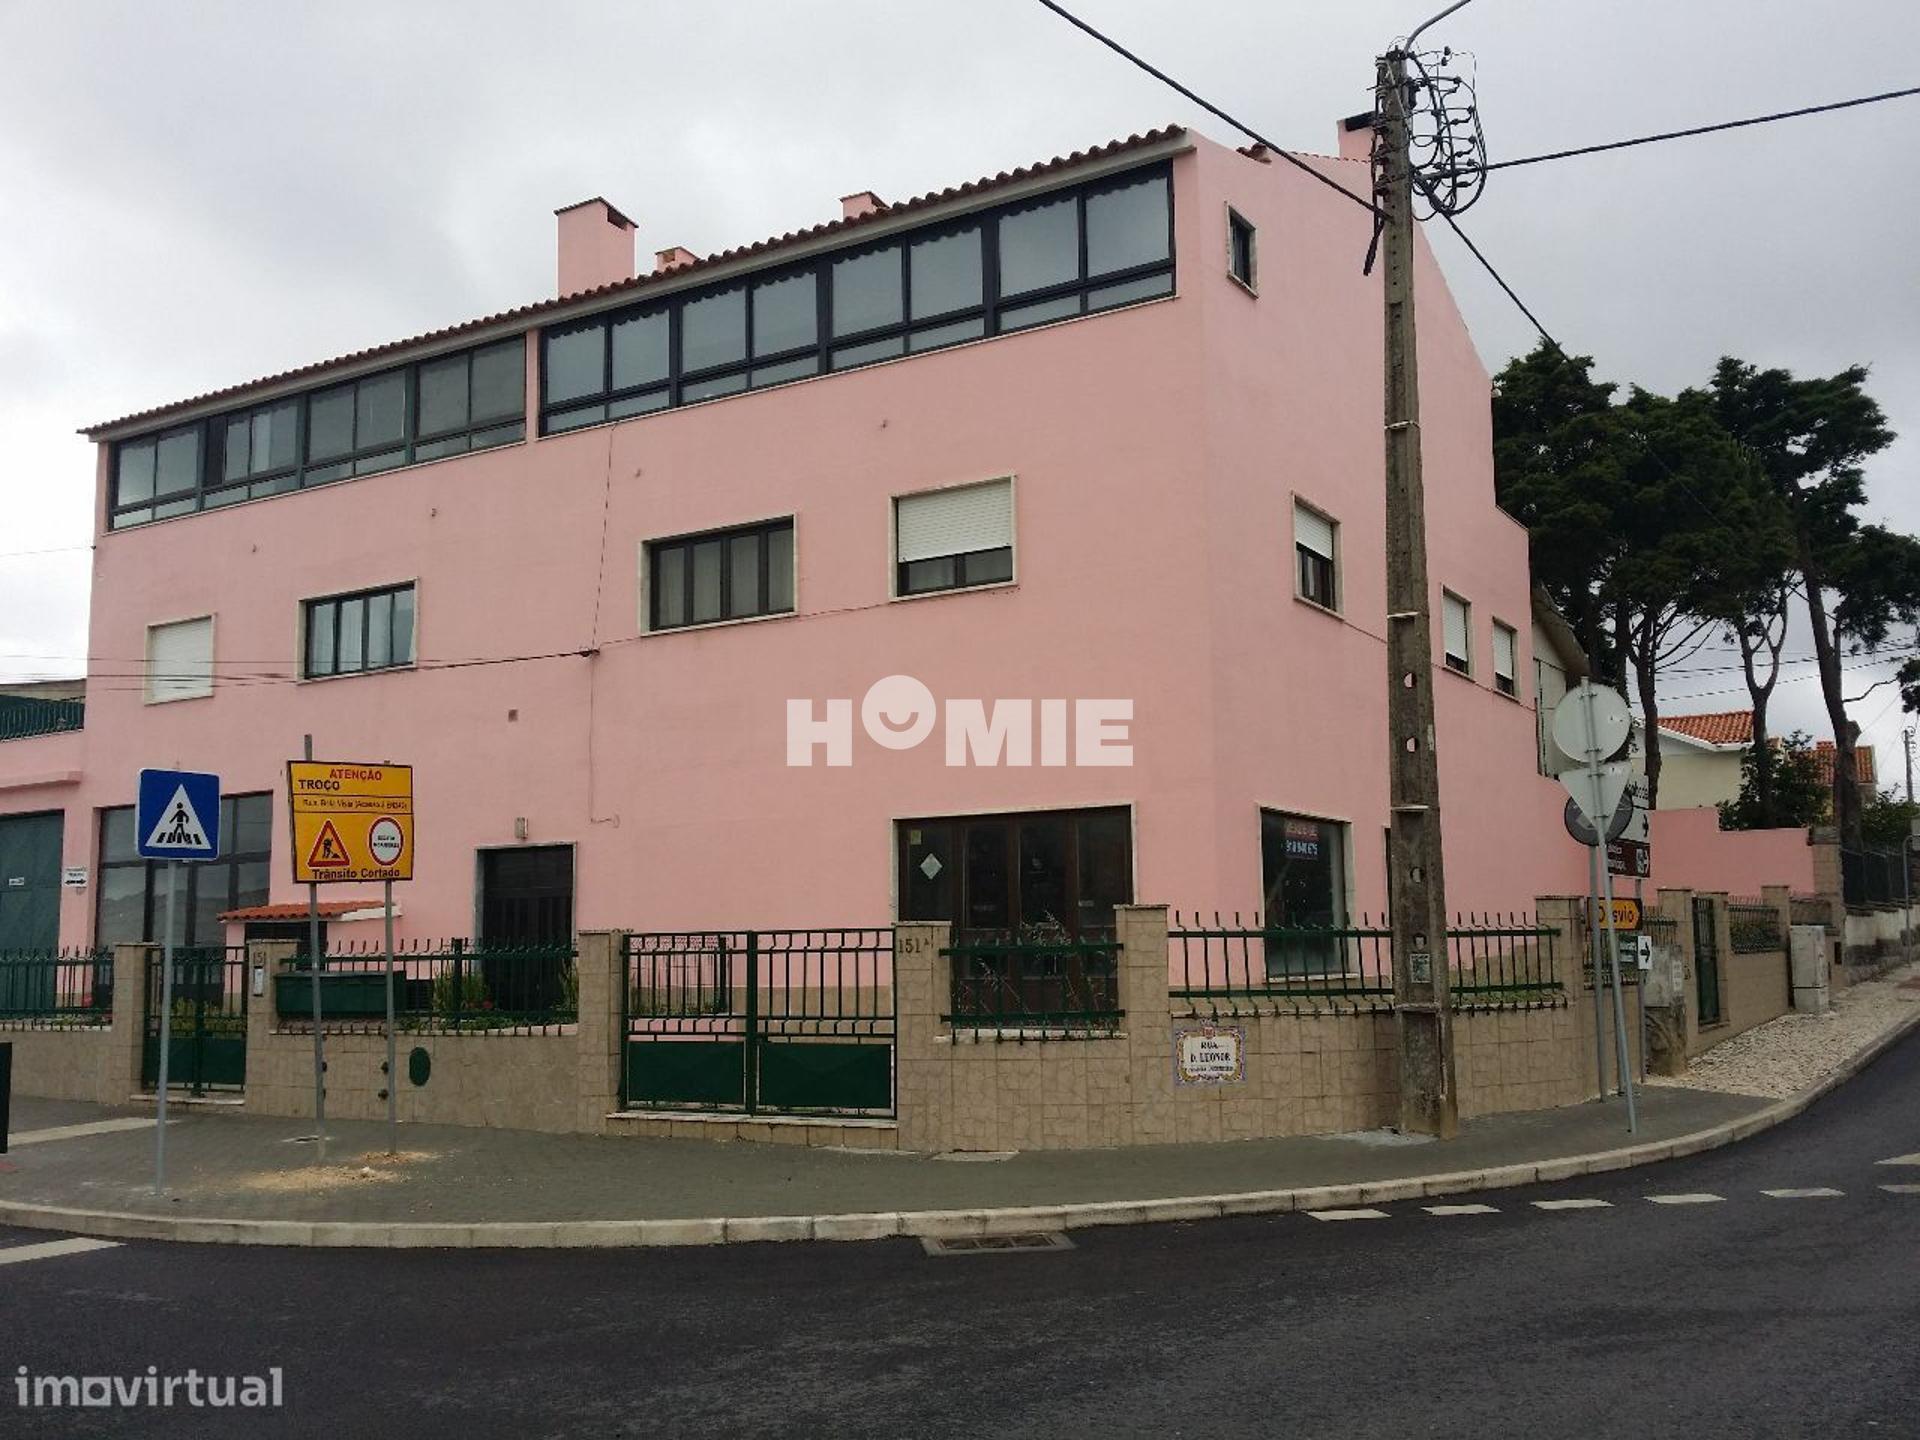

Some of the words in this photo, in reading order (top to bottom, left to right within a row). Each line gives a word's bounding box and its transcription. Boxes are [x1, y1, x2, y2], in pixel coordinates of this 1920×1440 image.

[329, 768, 382, 780] ATENÇÃO
[298, 779, 340, 792] TROÇO
[313, 868, 357, 880] Trânsito
[360, 867, 400, 879] Cortado
[1598, 905, 1635, 924] Dsvio
[1200, 1041, 1219, 1050] RUA
